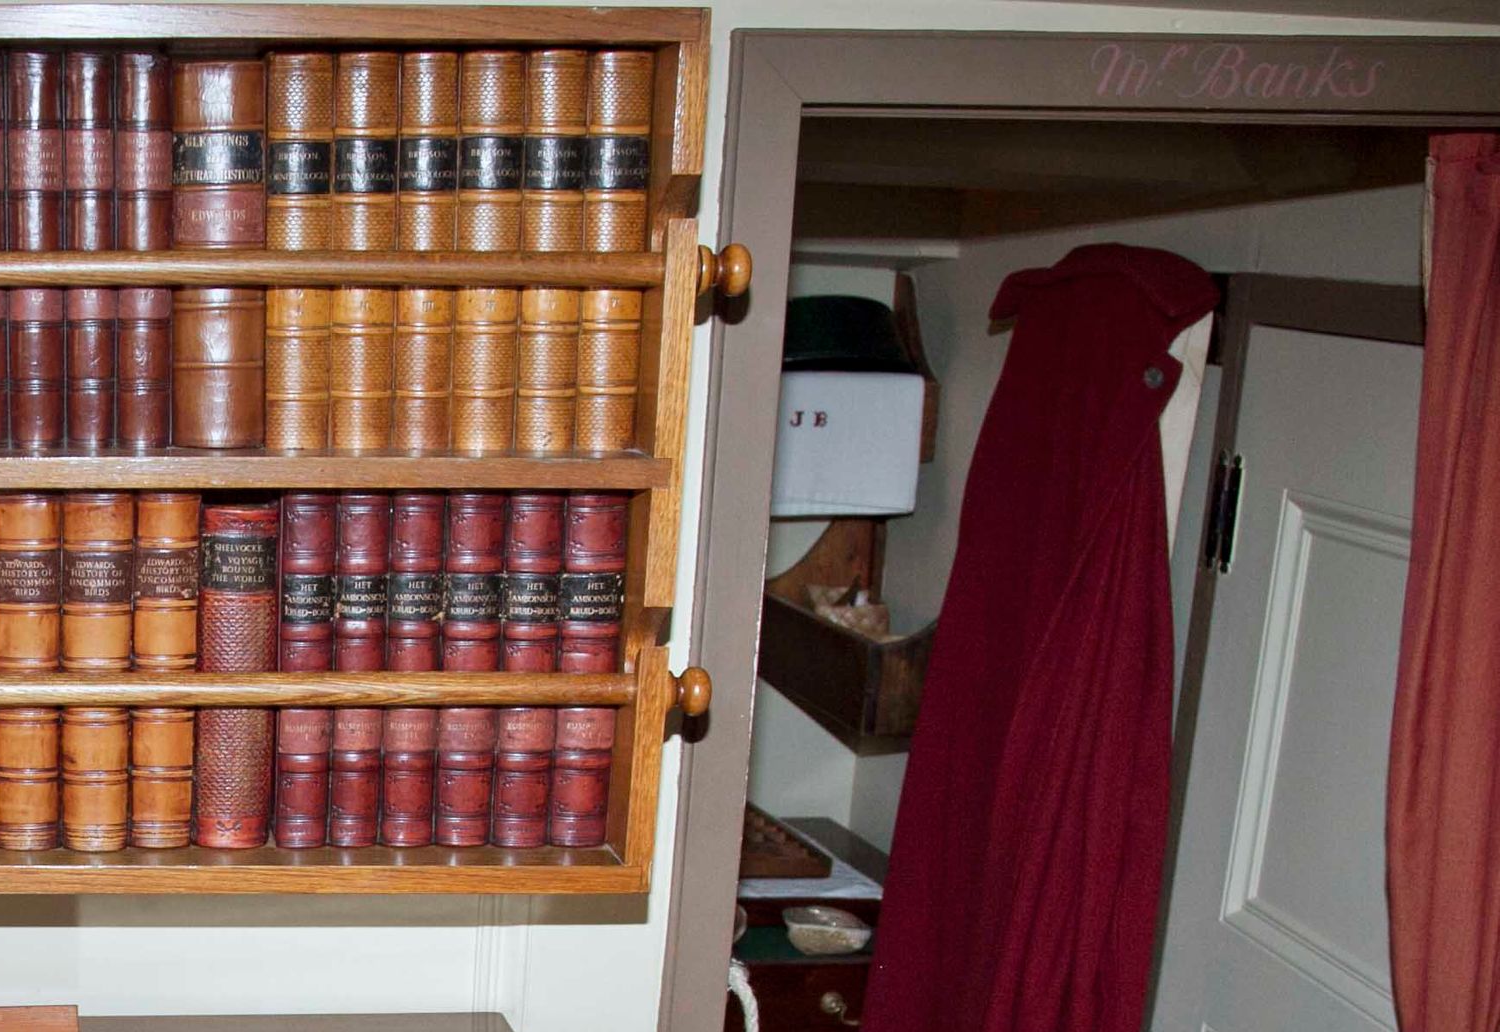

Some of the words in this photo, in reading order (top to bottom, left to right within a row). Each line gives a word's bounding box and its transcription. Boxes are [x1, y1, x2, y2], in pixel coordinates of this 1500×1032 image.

[1179, 42, 1385, 98] Banks
[214, 543, 265, 553] SHELVOCKE
[211, 574, 228, 582] THE
[233, 574, 265, 583] WORLD
[300, 583, 318, 592] HET
[354, 581, 372, 589] HET
[408, 581, 426, 589] HET
[467, 582, 484, 591] HET
[526, 582, 544, 591] HET
[587, 582, 605, 591] HET
